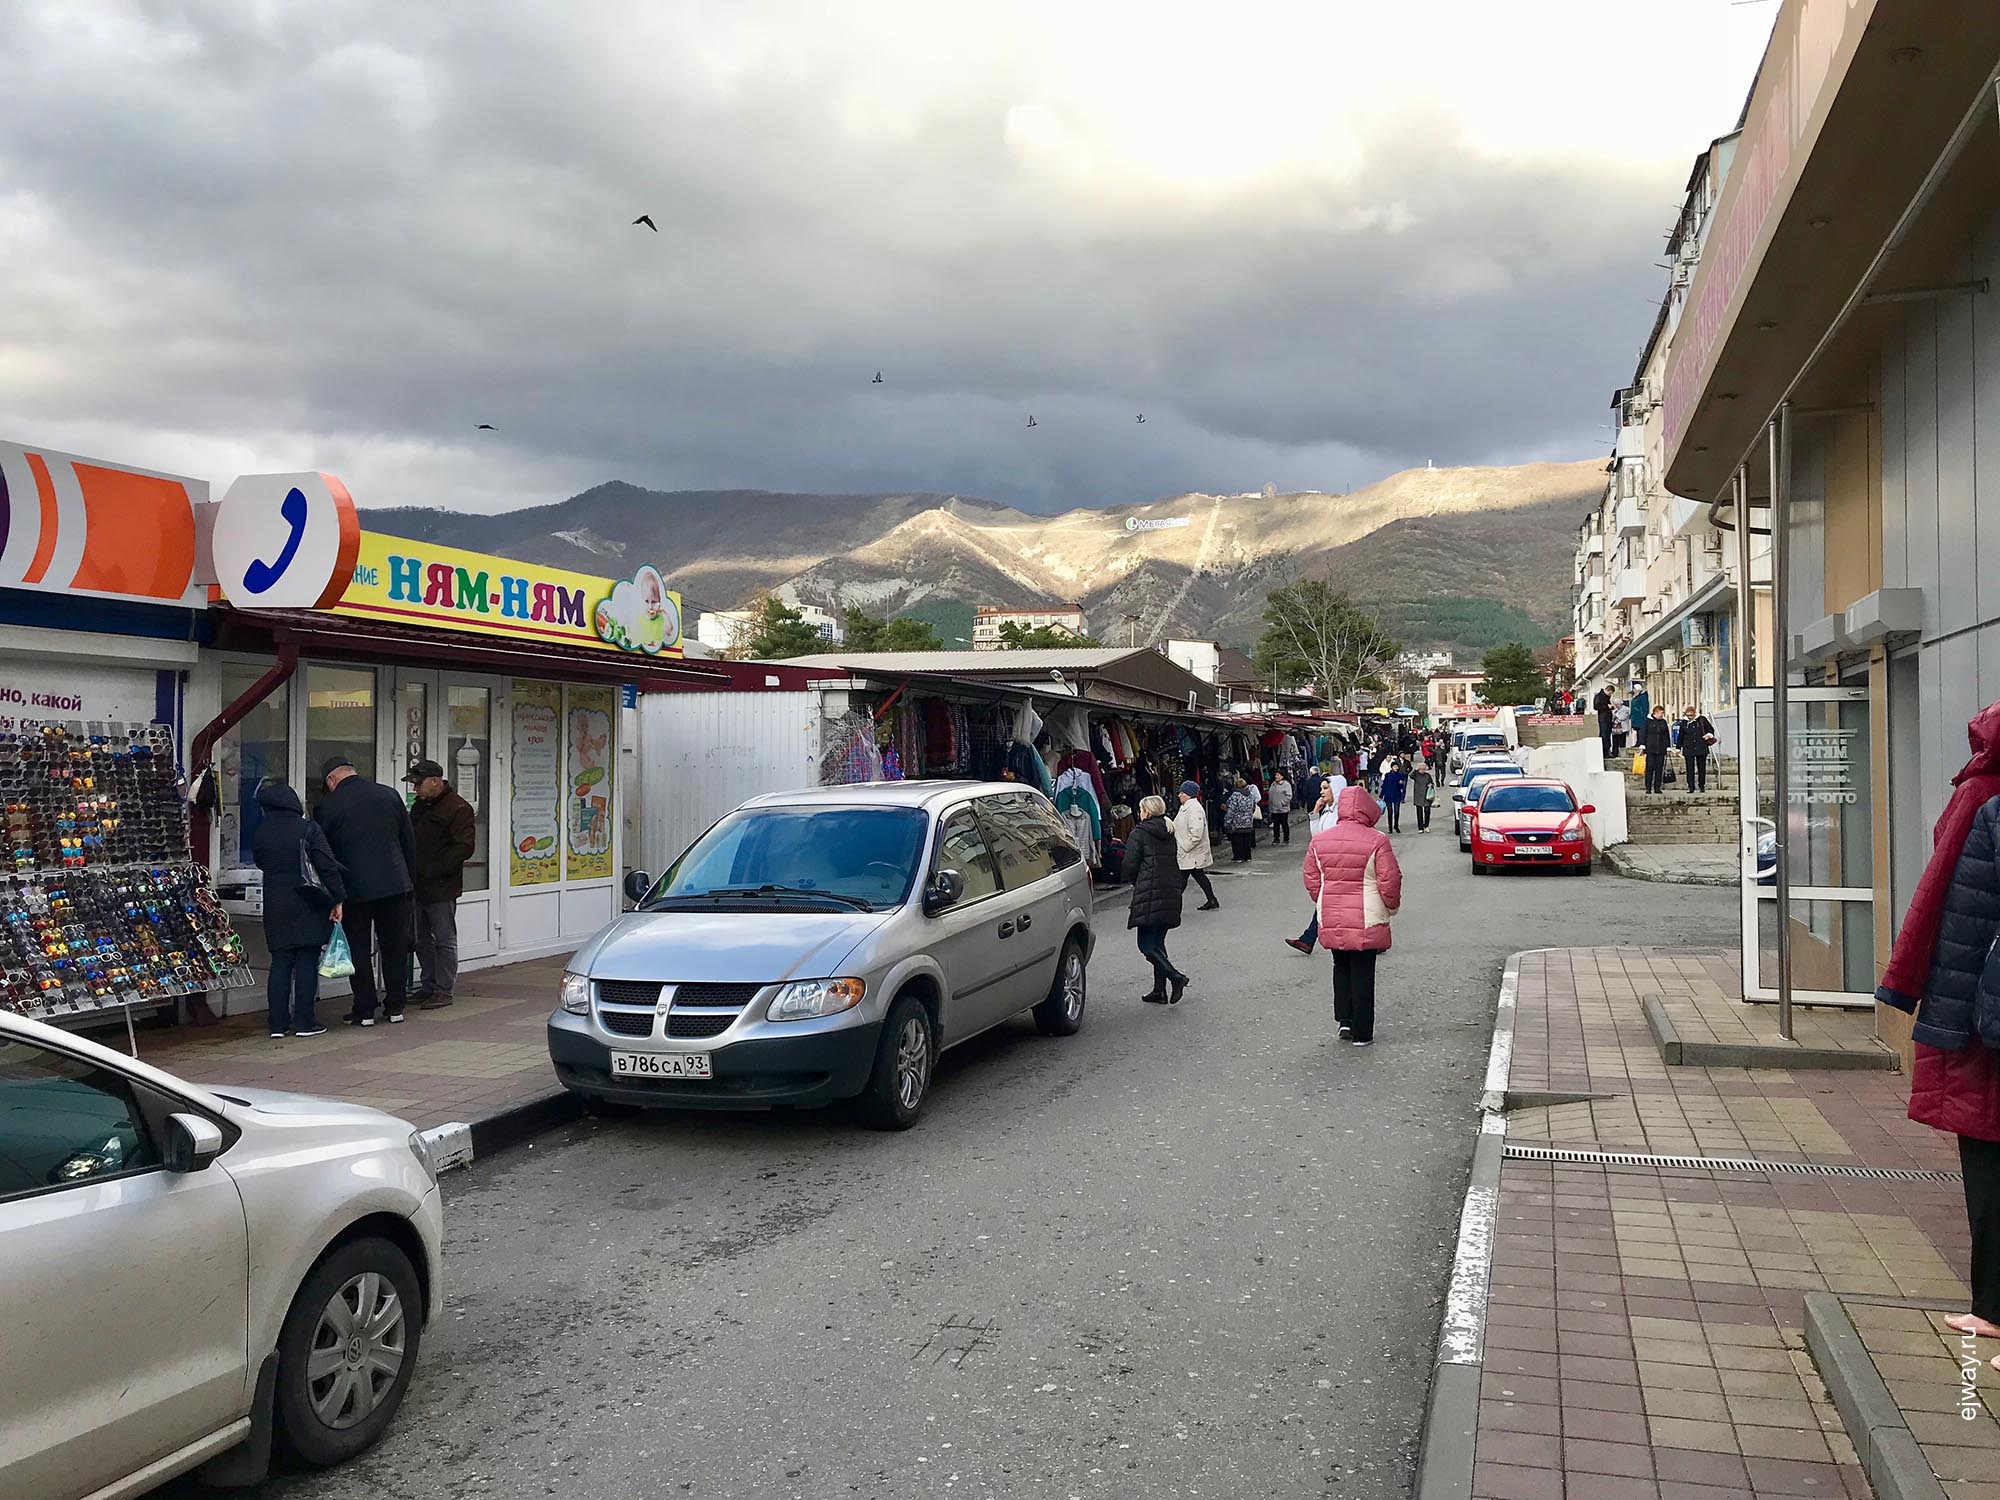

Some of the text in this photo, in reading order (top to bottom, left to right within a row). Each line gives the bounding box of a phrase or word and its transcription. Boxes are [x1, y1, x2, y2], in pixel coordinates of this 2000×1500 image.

[352, 565, 379, 586] НИЕ
[387, 554, 587, 628] НЯМ-НЯМ
[31, 692, 82, 711] какой
[617, 1055, 704, 1074] В786СА 93
